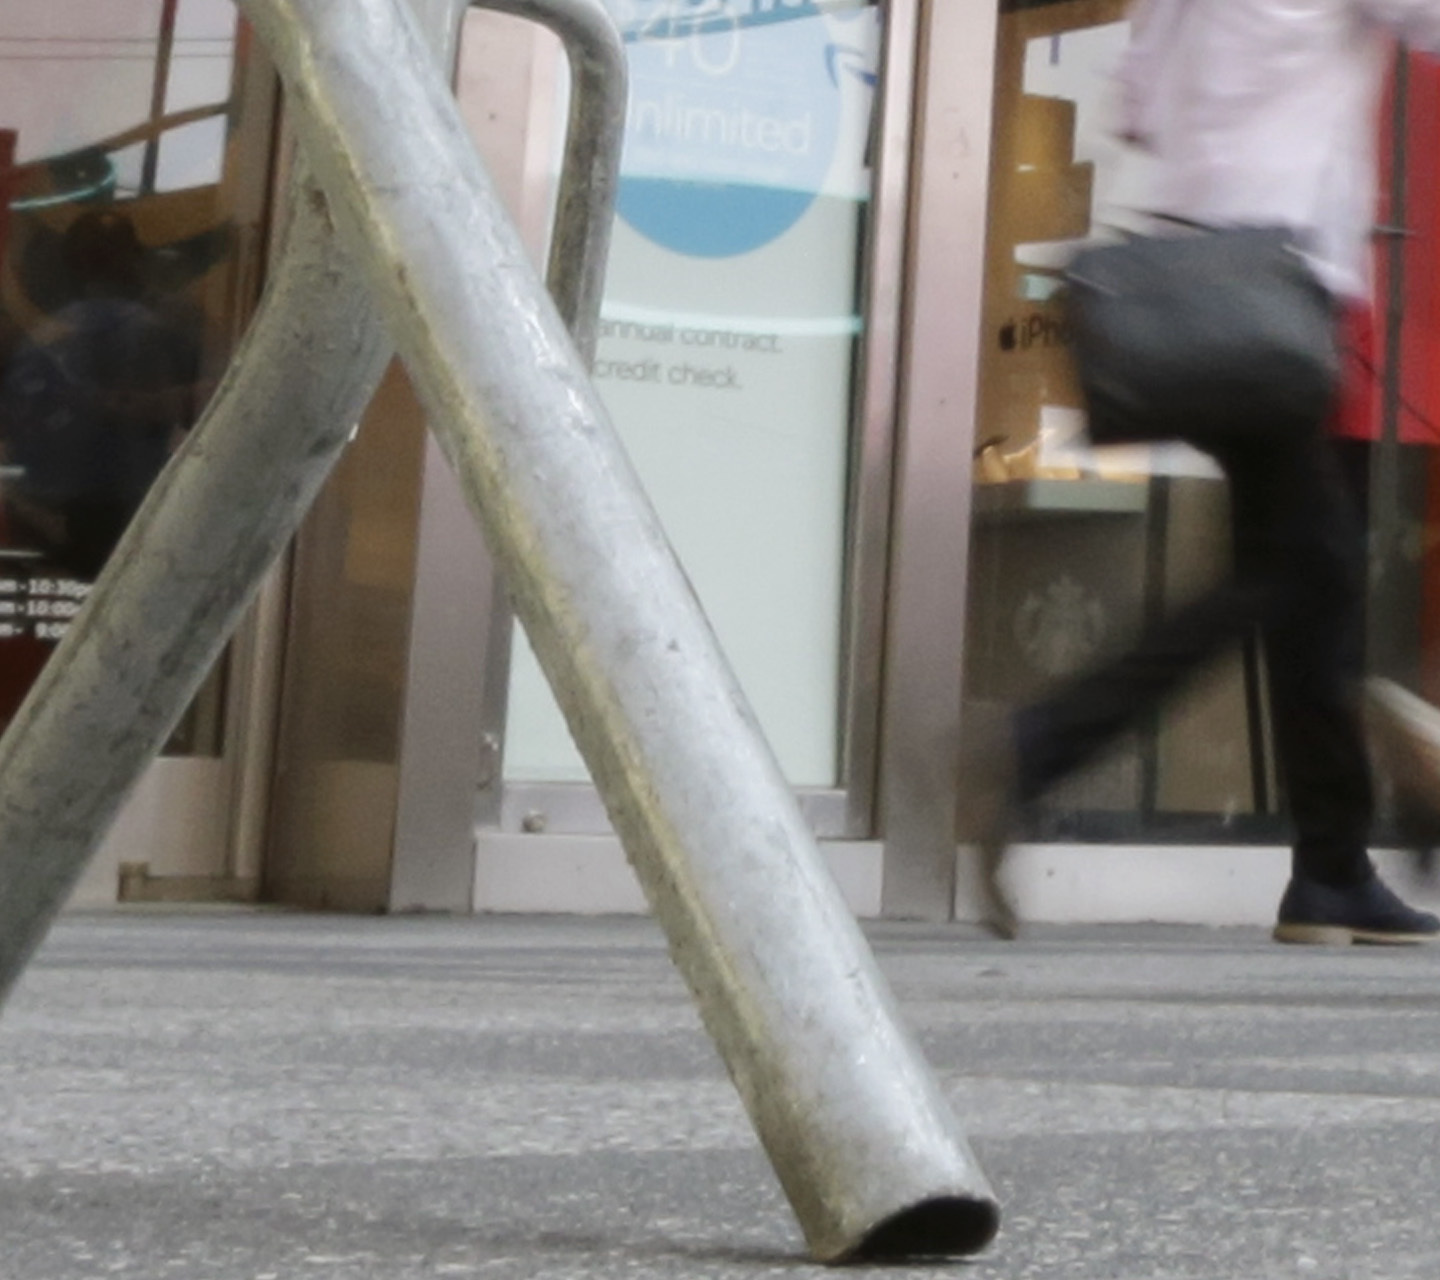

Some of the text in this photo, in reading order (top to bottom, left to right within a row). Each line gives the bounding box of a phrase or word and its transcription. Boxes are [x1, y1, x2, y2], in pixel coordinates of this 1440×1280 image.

[633, 90, 812, 156] nlimited
[597, 318, 784, 354] annual contract.
[593, 358, 744, 390] credit check.
